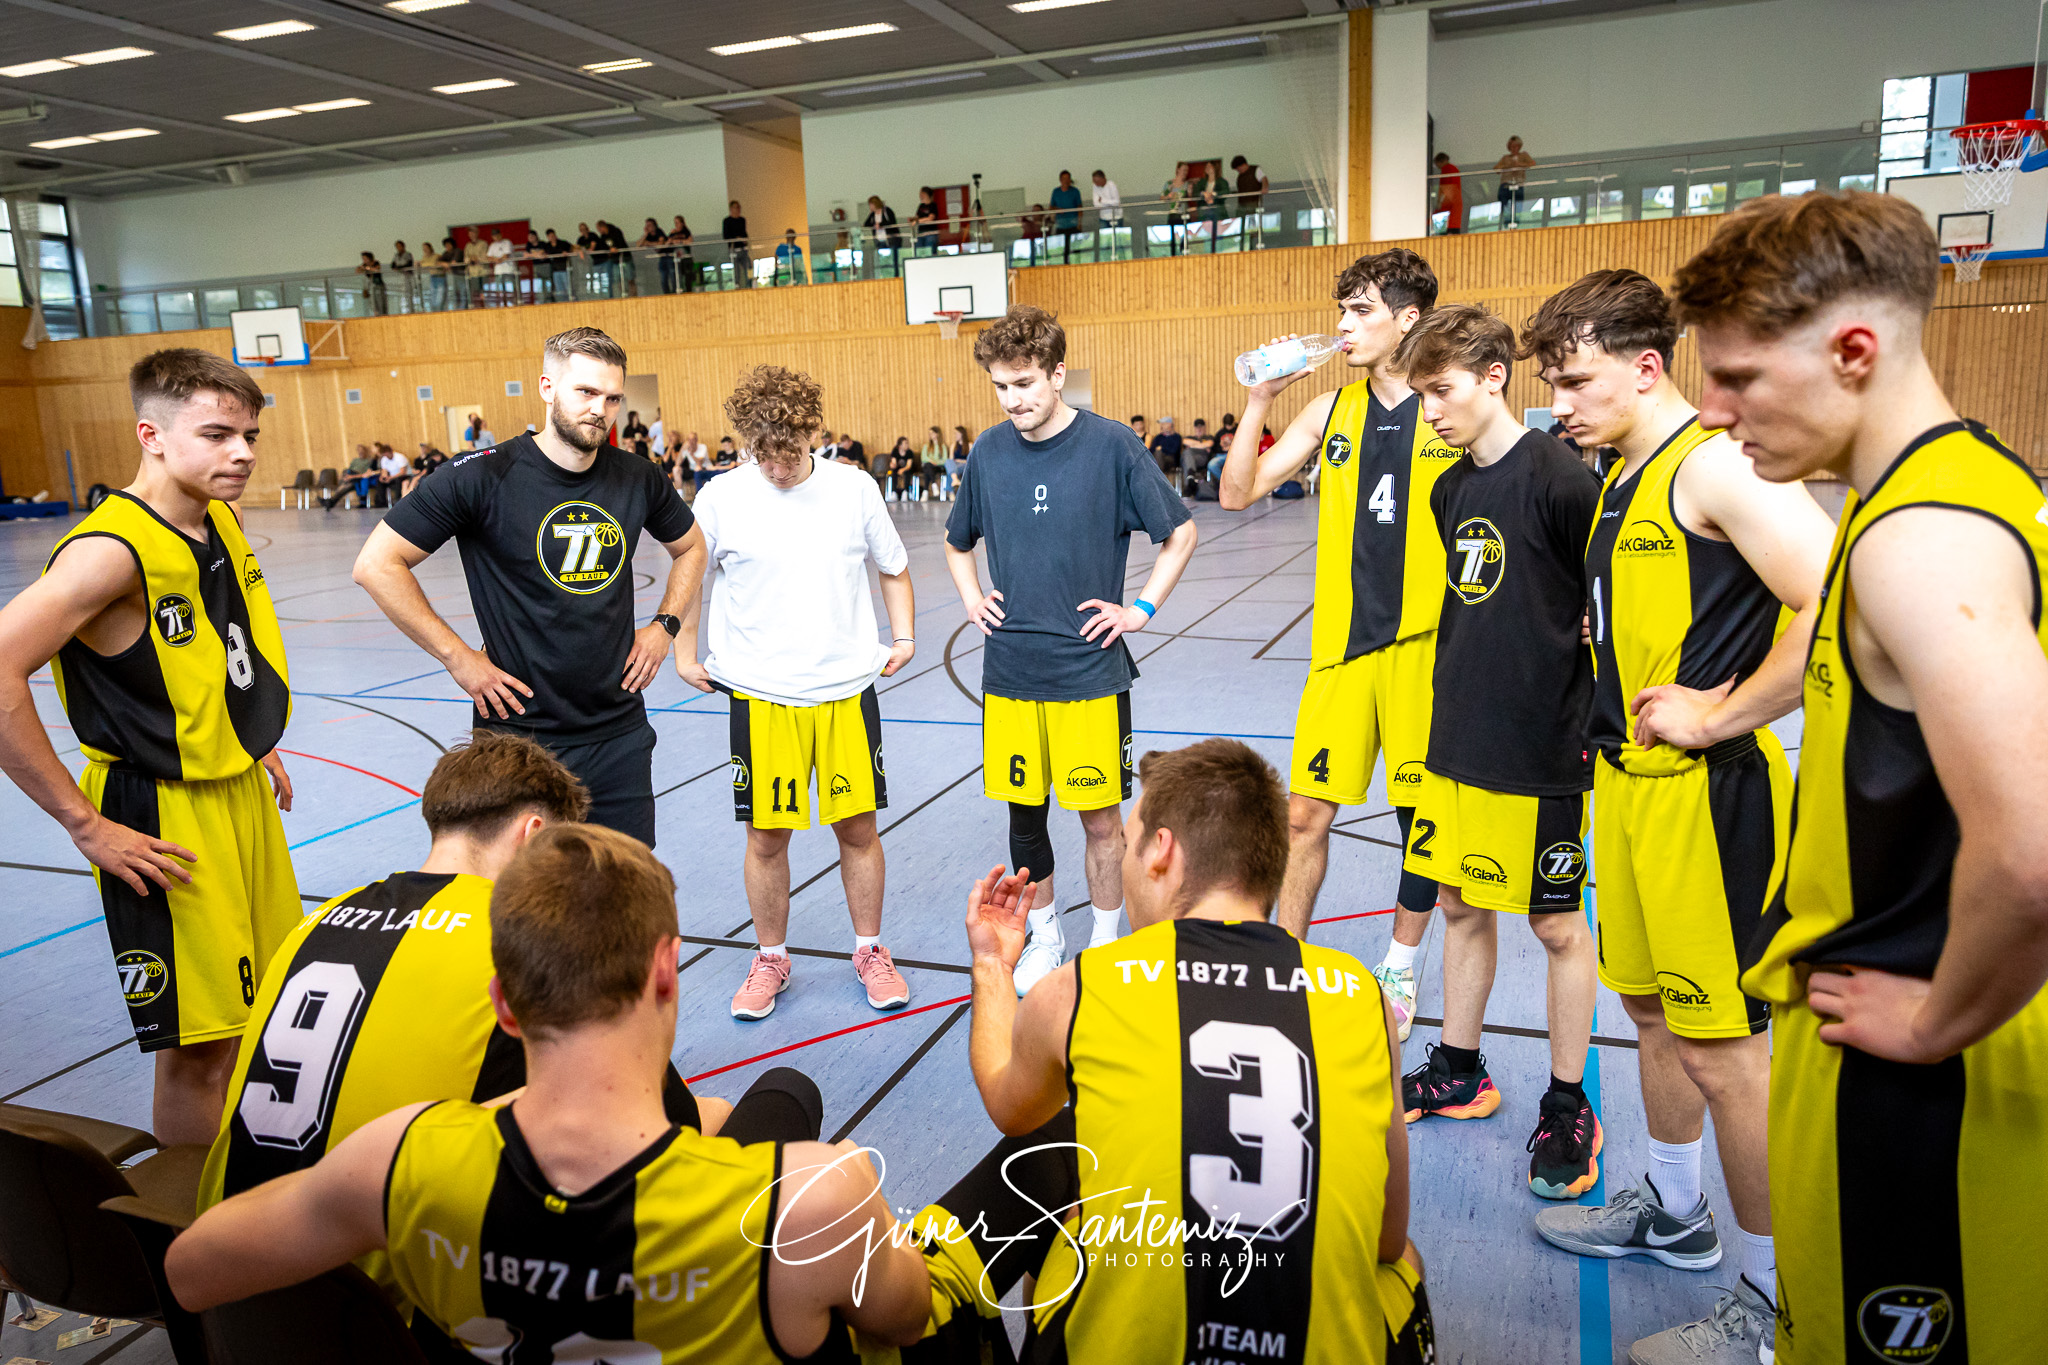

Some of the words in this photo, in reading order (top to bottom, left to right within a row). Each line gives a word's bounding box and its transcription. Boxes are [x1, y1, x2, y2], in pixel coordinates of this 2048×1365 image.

[1368, 473, 1397, 524] 4
[581, 572, 604, 580] LAUF
[226, 621, 255, 691] 8
[1009, 754, 1027, 789] 6
[1307, 747, 1331, 785] 4
[771, 776, 800, 815] 11
[1410, 818, 1438, 861] 2
[321, 905, 384, 931] 1877
[380, 907, 472, 934] LAUF
[238, 955, 255, 1009] 8
[1115, 959, 1166, 984] TV
[1176, 959, 1249, 987] 1877
[1265, 967, 1361, 998] LAUF
[1658, 983, 1711, 1005] KGlanz
[239, 960, 367, 1151] 9
[1188, 1019, 1314, 1242] 3
[420, 1228, 470, 1270] TV
[482, 1251, 570, 1300] 1877
[584, 1267, 710, 1302] LAUF
